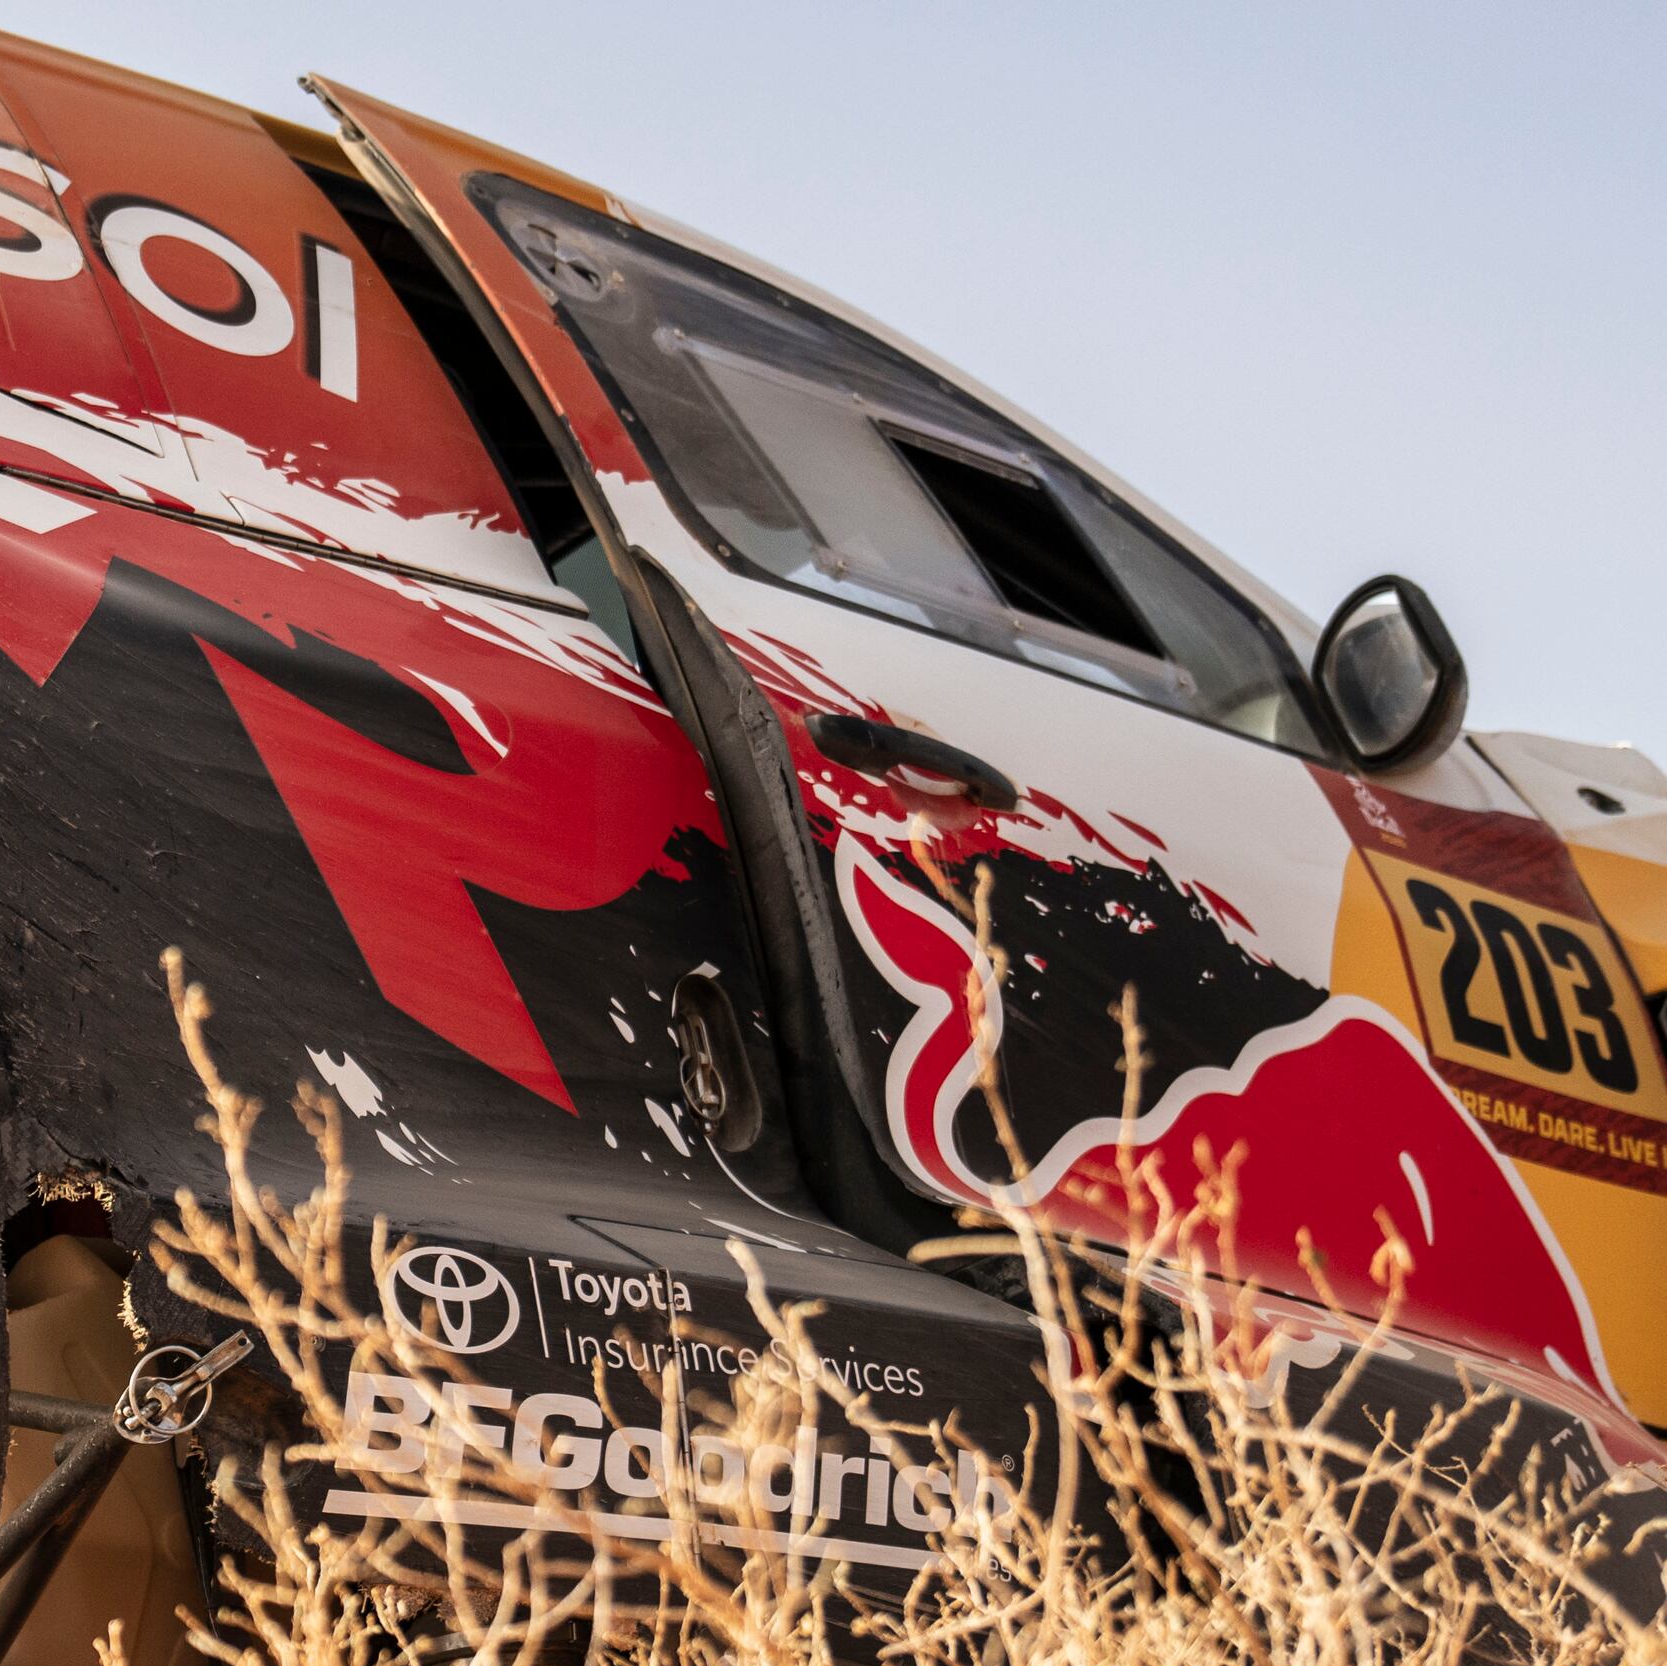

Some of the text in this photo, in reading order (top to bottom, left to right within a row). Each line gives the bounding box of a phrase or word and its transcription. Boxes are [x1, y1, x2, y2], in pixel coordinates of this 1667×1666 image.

[1405, 877, 1639, 1095] 203
[1538, 1110, 1605, 1154] DARE.
[1608, 1131, 1659, 1169] LIVE
[548, 1258, 693, 1316] Toyota
